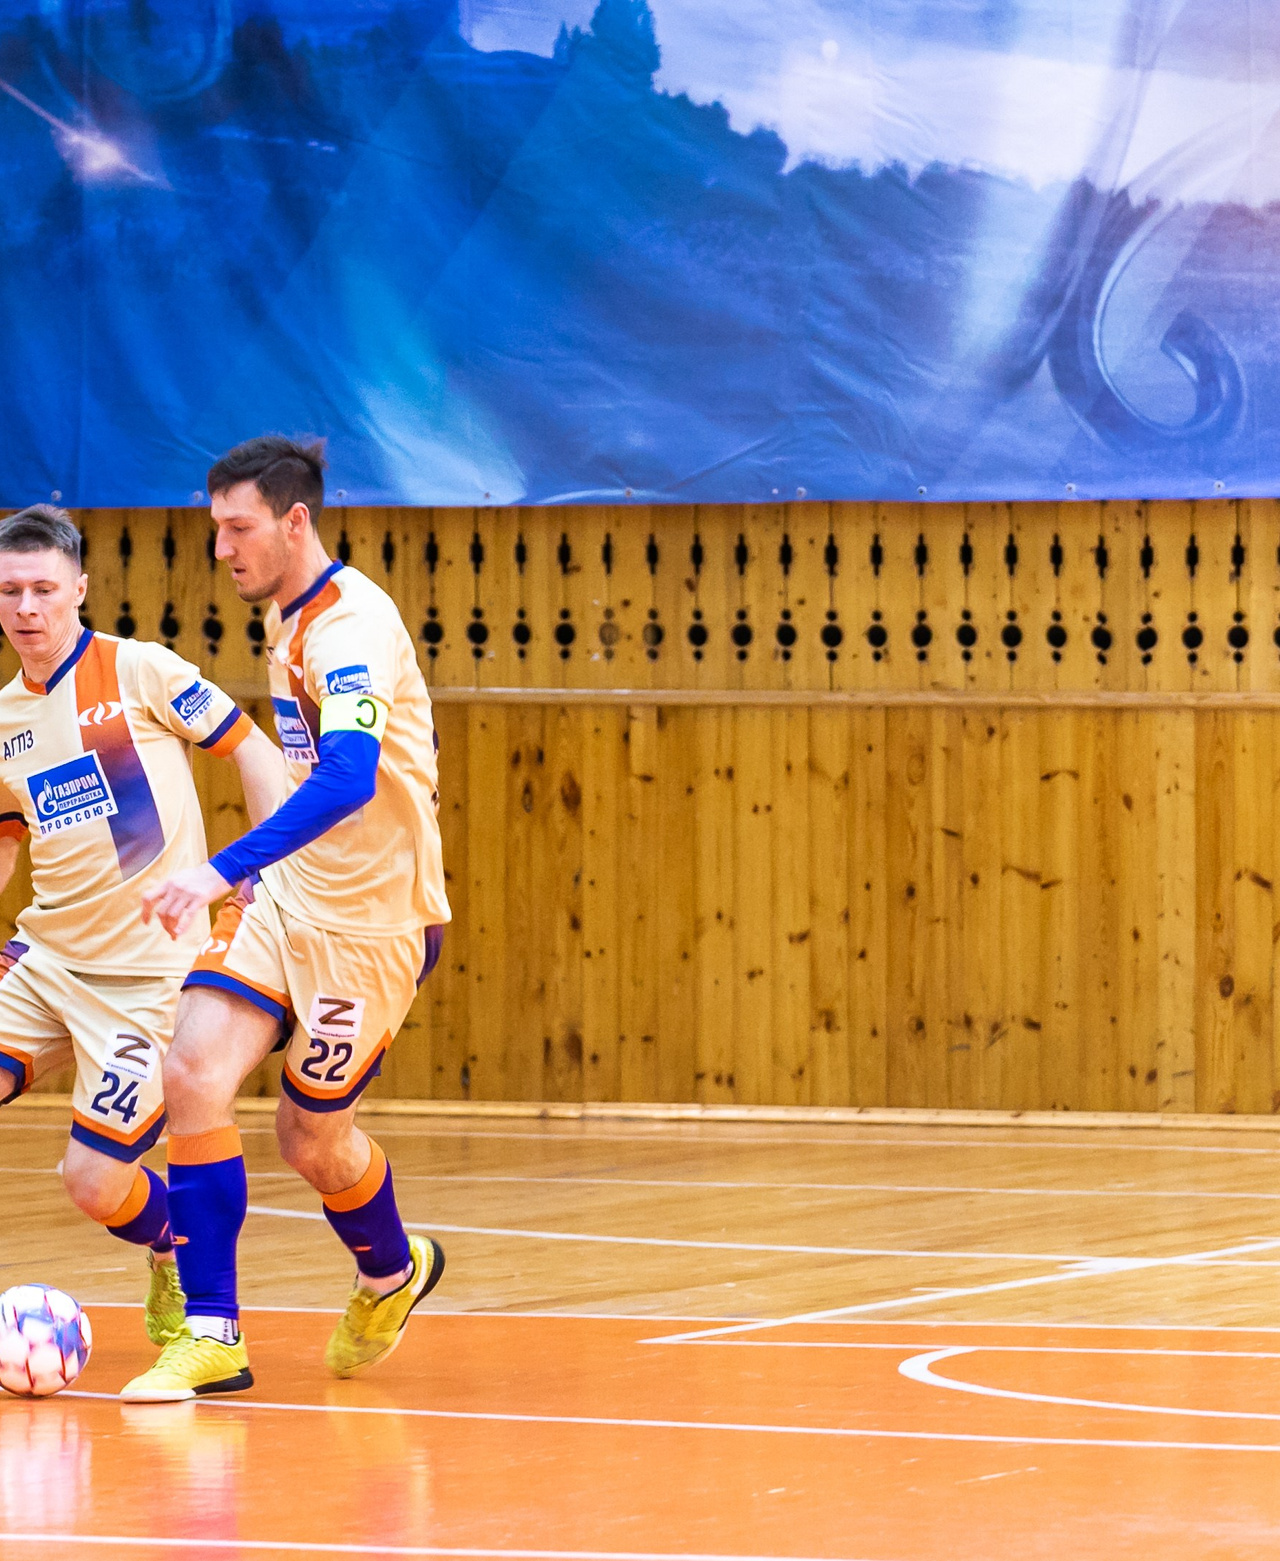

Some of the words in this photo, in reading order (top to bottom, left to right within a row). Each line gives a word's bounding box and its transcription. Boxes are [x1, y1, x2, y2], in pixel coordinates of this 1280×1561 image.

[3, 729, 34, 761] АГПЗ
[52, 772, 100, 800] ГАЗПРОМ
[59, 789, 103, 811] ПЕРЕРАБОТКА
[40, 802, 114, 835] ПРОФСОЮЗ
[300, 1038, 353, 1082] 22
[91, 1070, 139, 1124] 24
